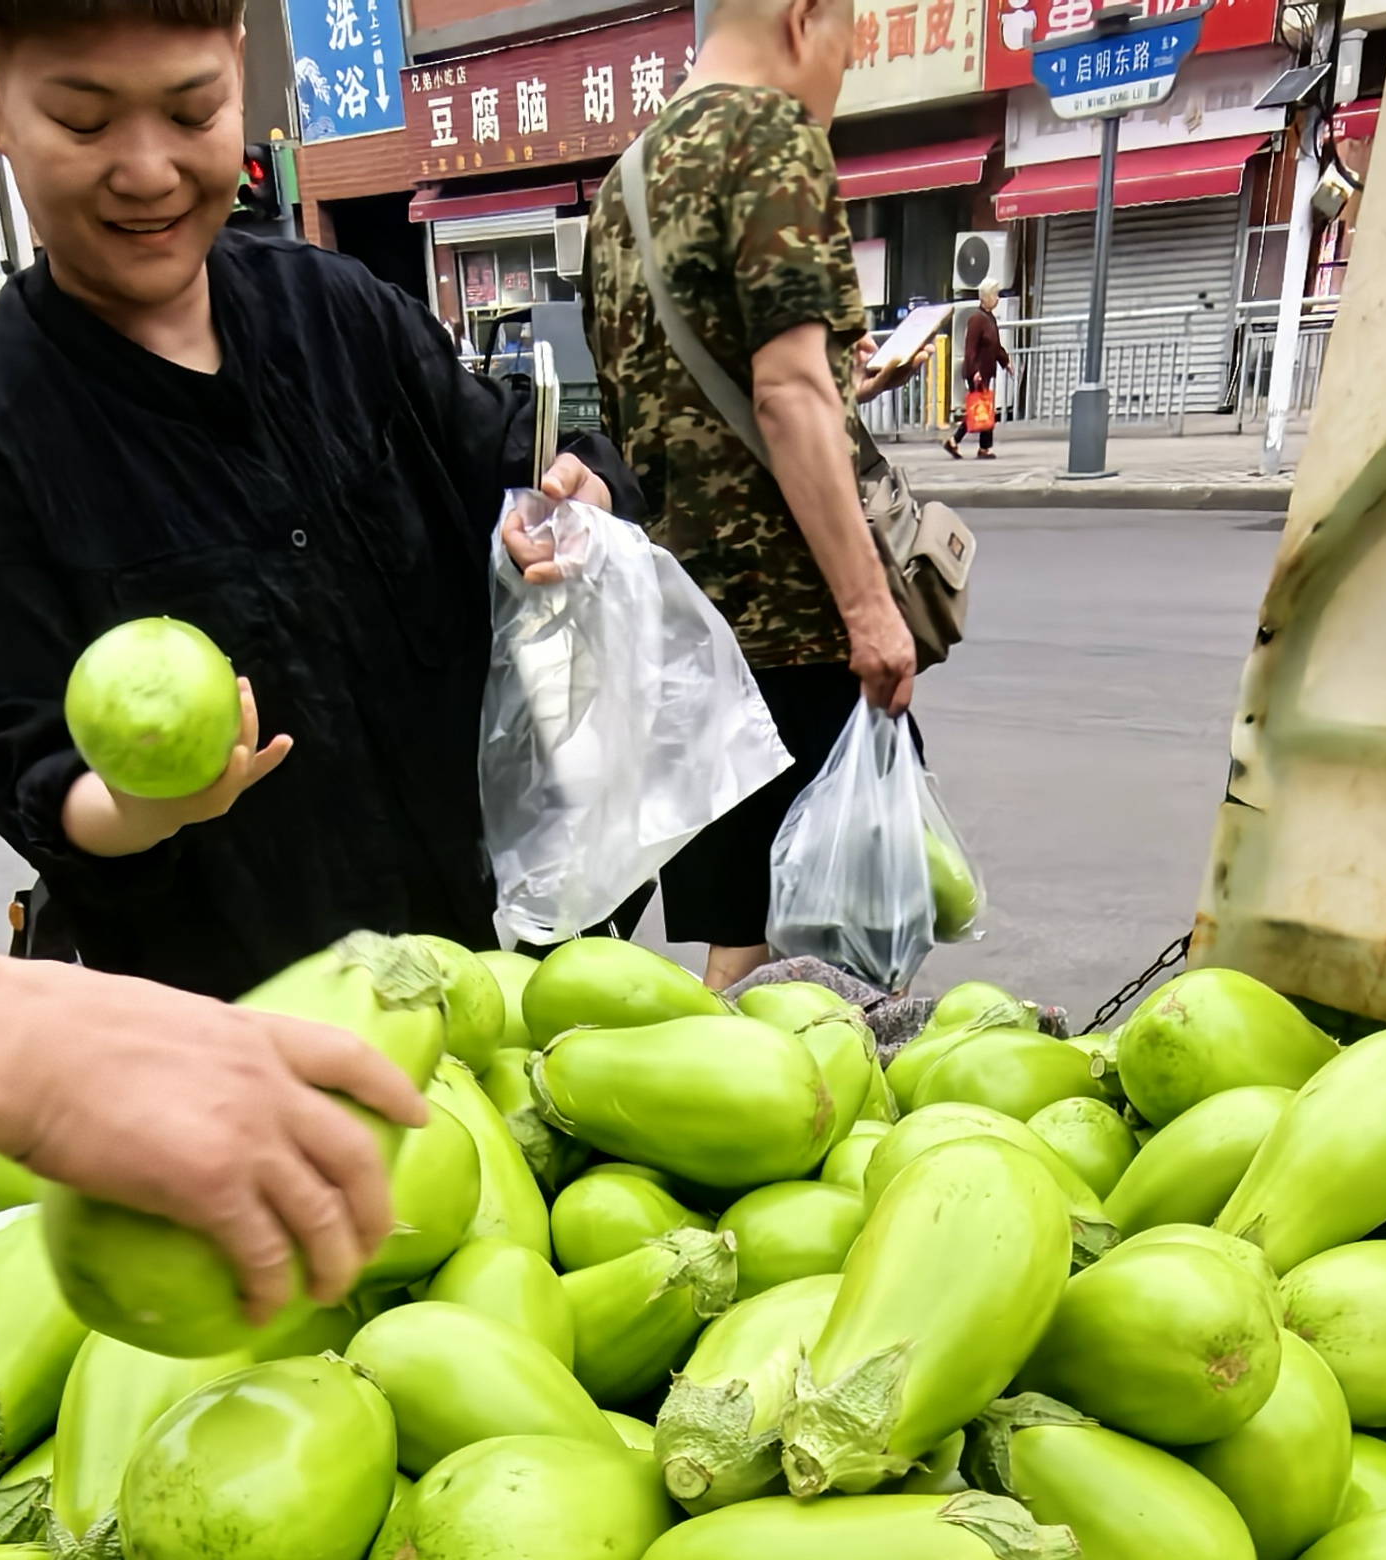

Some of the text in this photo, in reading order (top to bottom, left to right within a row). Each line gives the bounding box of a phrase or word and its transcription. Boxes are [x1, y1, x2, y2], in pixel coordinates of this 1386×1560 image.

[326, 0, 370, 119] 洗浴
[411, 65, 468, 93] 兄弟小吃店
[1076, 40, 1150, 83] 启明东路
[428, 77, 548, 147] 豆腐脑
